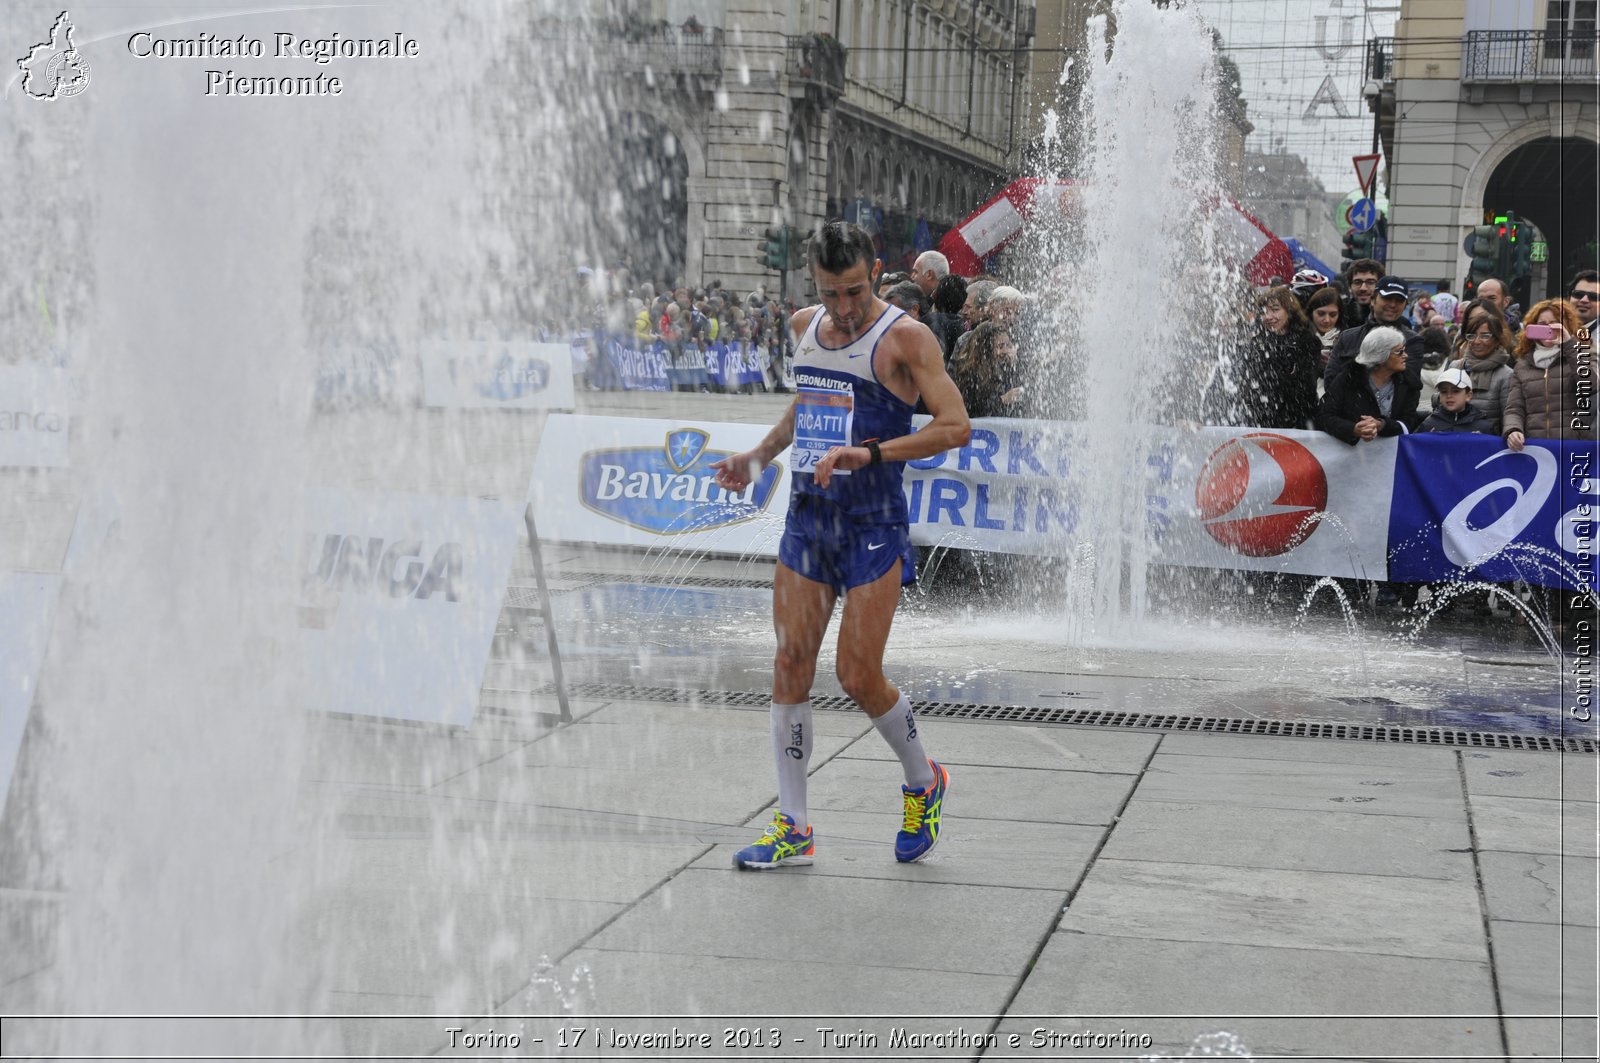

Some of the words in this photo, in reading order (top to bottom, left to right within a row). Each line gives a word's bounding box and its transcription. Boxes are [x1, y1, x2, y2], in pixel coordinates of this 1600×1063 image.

[615, 342, 669, 380] Bavaria
[796, 374, 853, 391] AERONAUTICA
[797, 413, 843, 433] RICATTI
